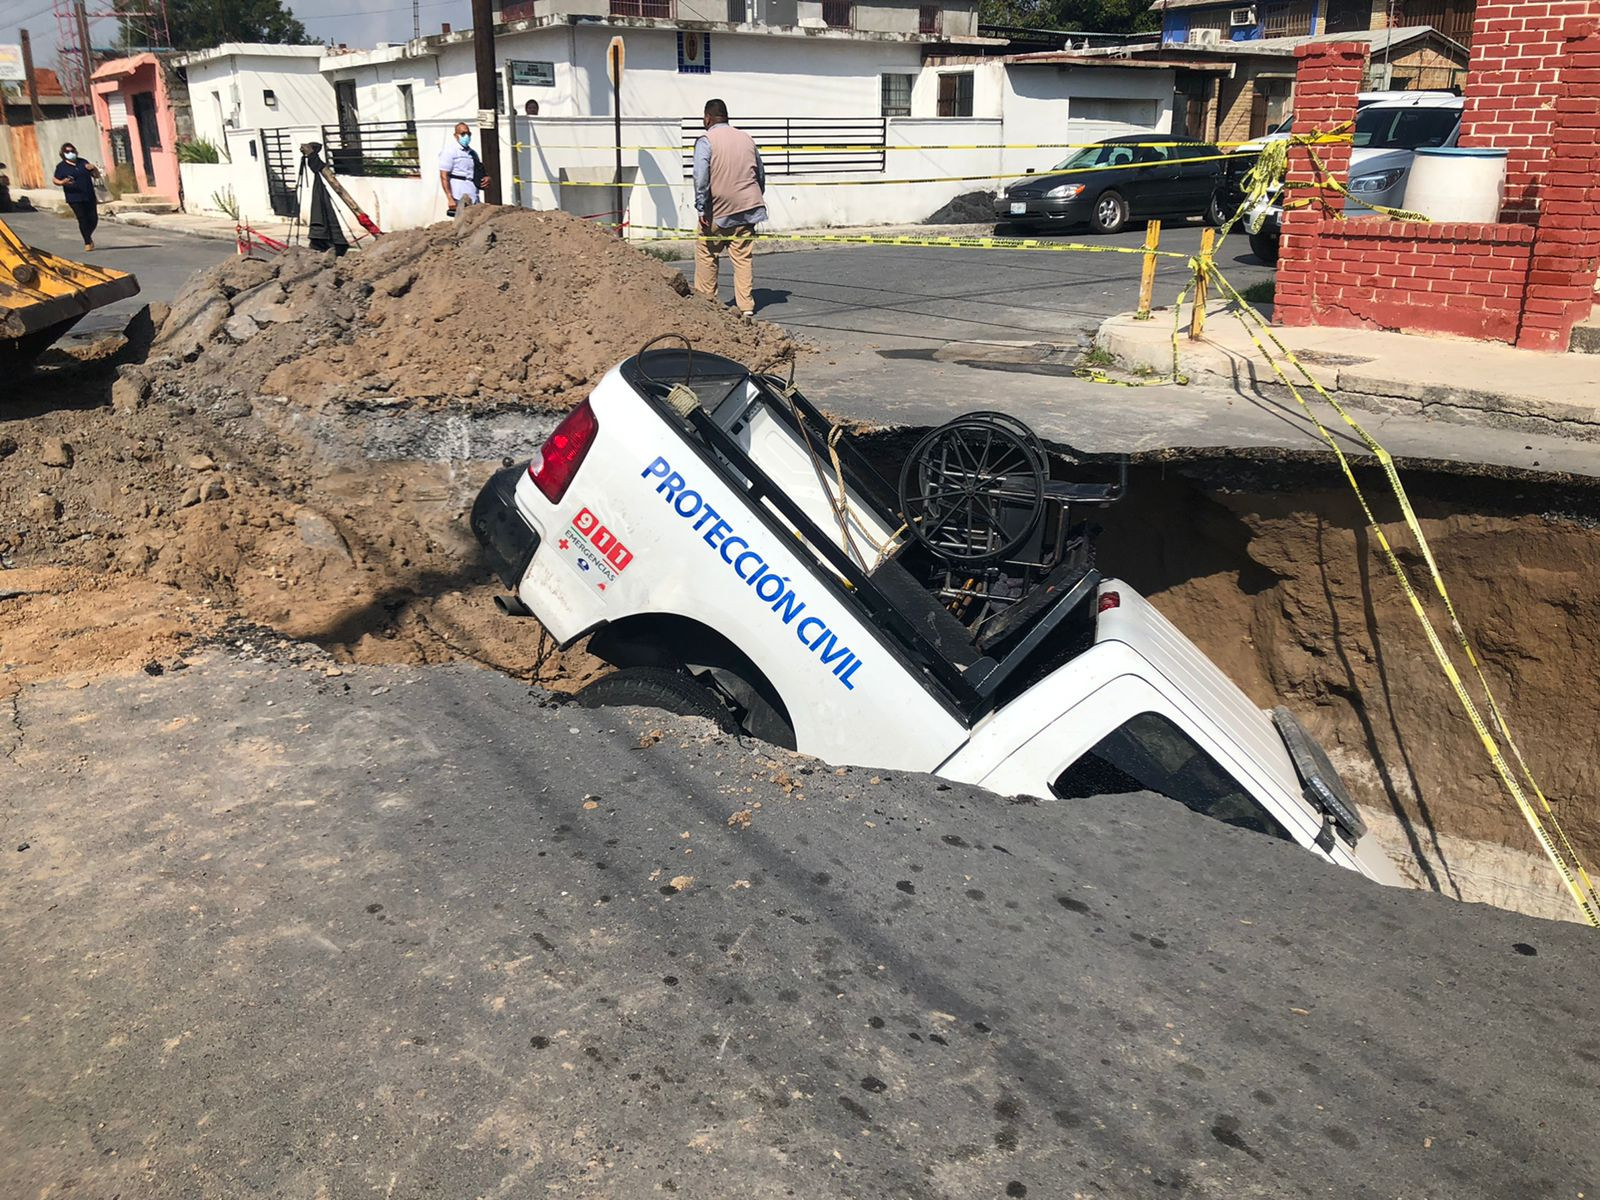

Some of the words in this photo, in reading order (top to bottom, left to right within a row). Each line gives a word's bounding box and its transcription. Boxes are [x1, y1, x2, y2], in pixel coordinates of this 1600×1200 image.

[564, 530, 616, 582] EMERGENCIAS
[576, 511, 628, 565] 911
[641, 456, 806, 625] PROTECCIÓN
[797, 616, 863, 691] CIVIL
